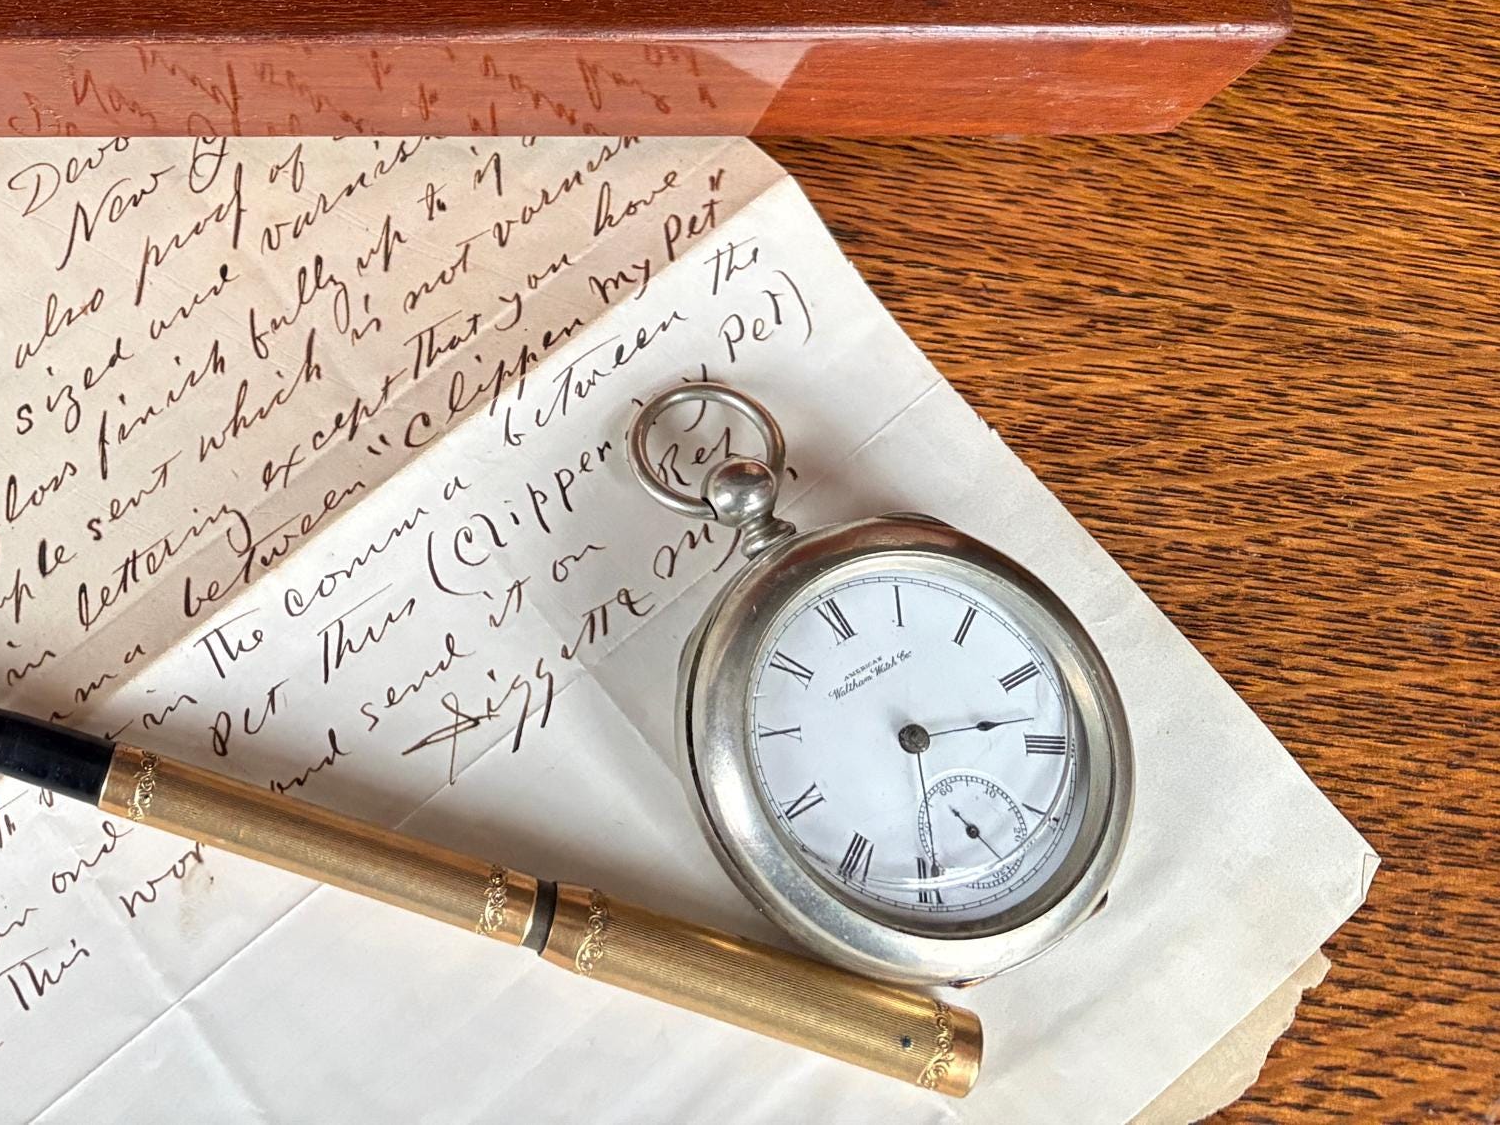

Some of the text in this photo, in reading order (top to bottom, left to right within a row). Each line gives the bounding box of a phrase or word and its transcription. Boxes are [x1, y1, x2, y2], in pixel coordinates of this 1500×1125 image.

[7, 136, 130, 218] Devo
[14, 287, 105, 370] also
[133, 161, 248, 308] proof
[268, 142, 305, 194] of
[16, 336, 135, 436] sized
[149, 263, 240, 341] and
[260, 137, 425, 255] varnis
[55, 164, 176, 272] New
[6, 640, 57, 687] in
[77, 503, 252, 629] lettering
[261, 367, 408, 492] except
[494, 253, 575, 332] you
[593, 170, 679, 238] have
[86, 450, 183, 542] sent
[199, 327, 323, 463] which
[350, 291, 384, 347] is
[402, 230, 492, 315] not
[97, 338, 226, 481] finish
[249, 253, 350, 362] fully
[356, 214, 408, 278] up
[416, 182, 448, 222] to
[469, 145, 503, 198] if
[142, 689, 198, 730] in
[284, 475, 472, 618] comma
[503, 310, 689, 447] between
[183, 480, 367, 619] between
[51, 816, 134, 895] and
[208, 678, 289, 758] Pet
[118, 841, 205, 919] wor
[359, 632, 472, 732] send
[482, 575, 531, 629] it
[552, 544, 607, 583] on
[828, 675, 873, 699] Waltham
[870, 656, 897, 676] Watch
